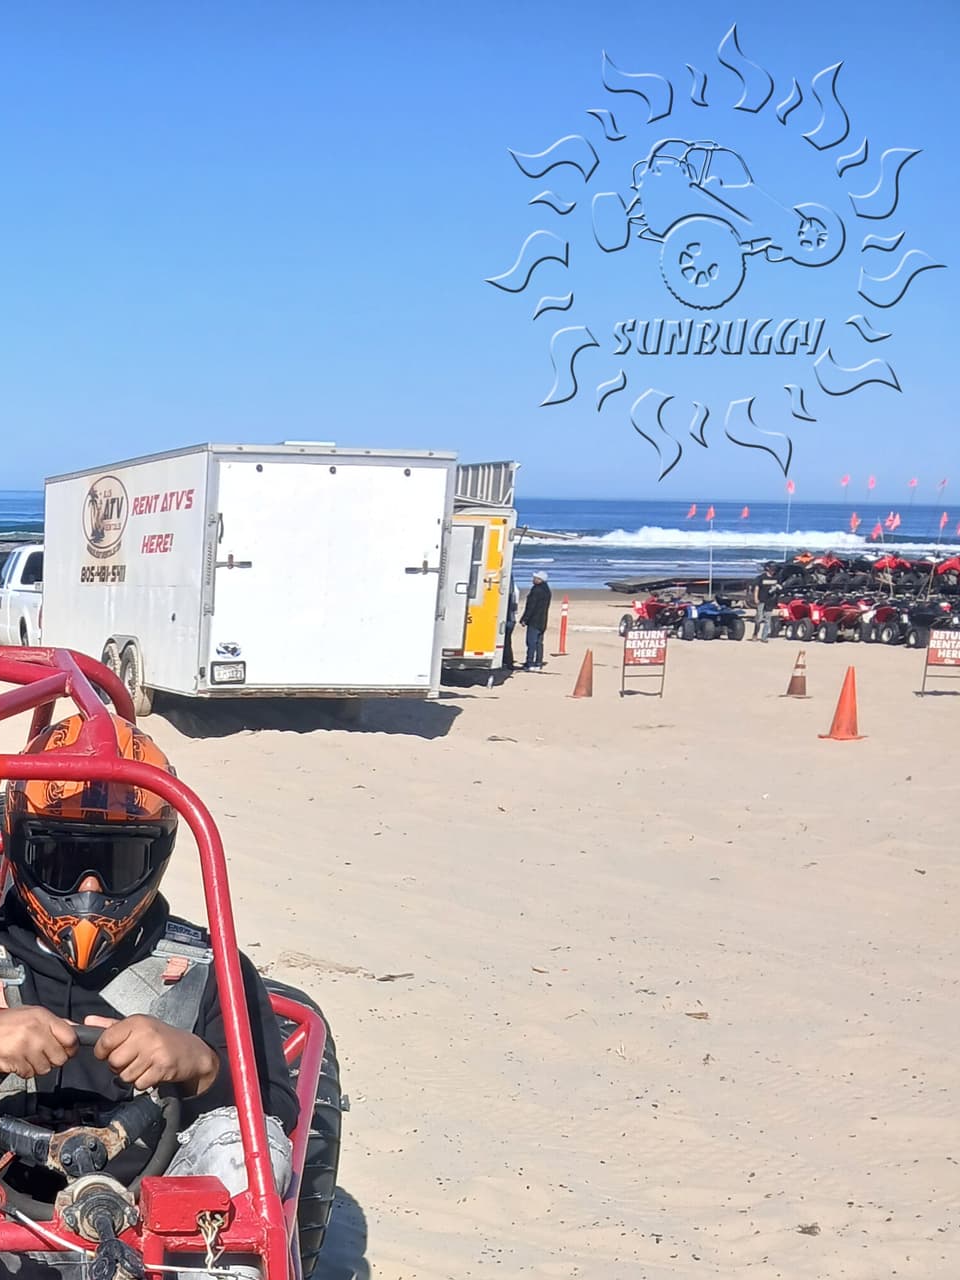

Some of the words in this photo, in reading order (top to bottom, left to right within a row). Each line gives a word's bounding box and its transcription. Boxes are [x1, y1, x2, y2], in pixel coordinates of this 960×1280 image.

[102, 496, 124, 520] ATV
[131, 495, 160, 516] RENT
[160, 489, 195, 512] ATV'S
[141, 533, 174, 554] HERE!
[628, 630, 665, 639] RETURN
[626, 640, 666, 648] RENTALS
[633, 649, 657, 657] HERE
